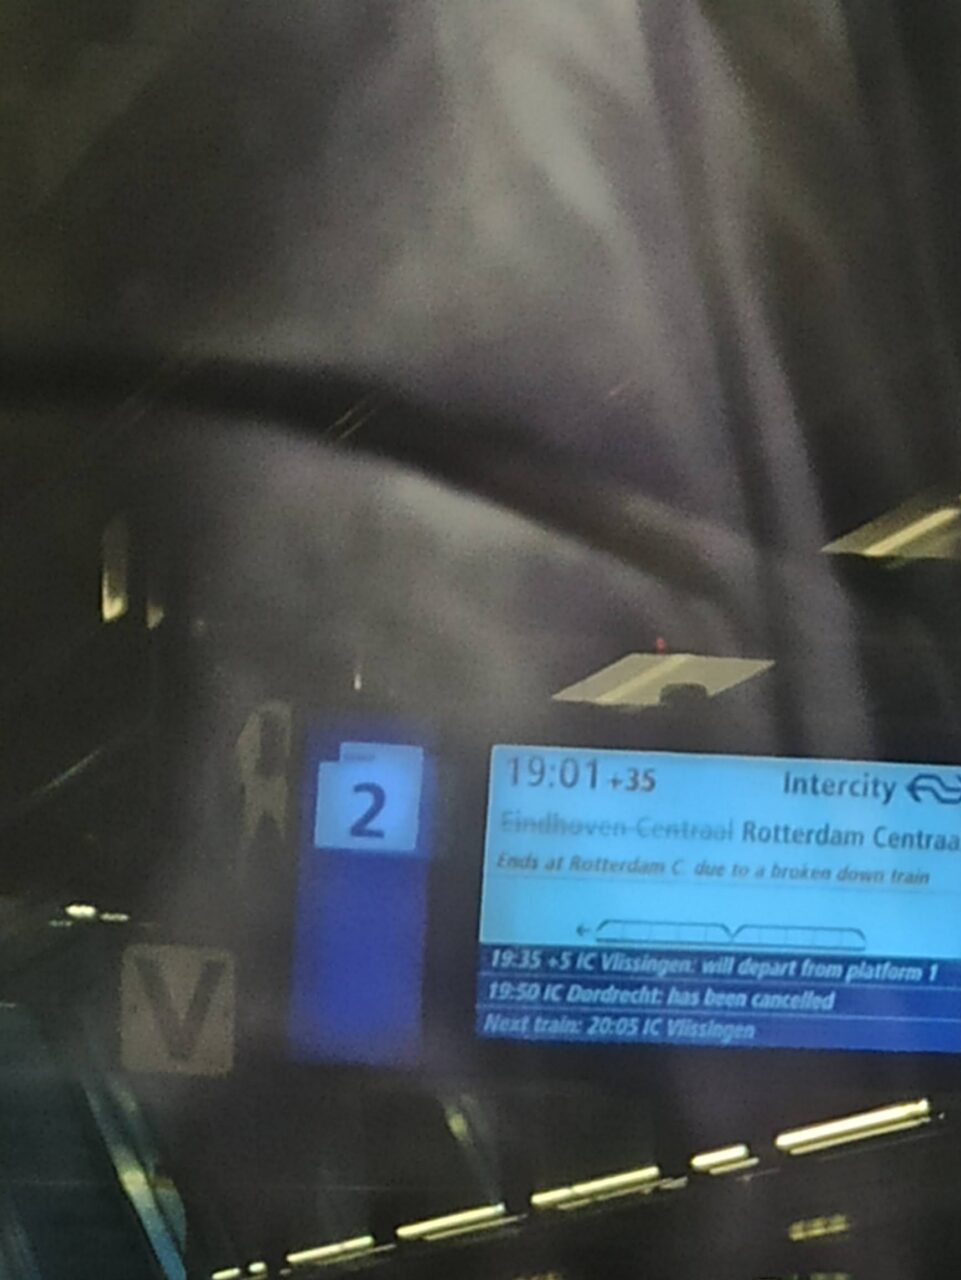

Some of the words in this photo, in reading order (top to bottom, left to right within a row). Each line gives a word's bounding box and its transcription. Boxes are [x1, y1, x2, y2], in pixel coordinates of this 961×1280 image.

[507, 755, 598, 790] 19:01
[608, 766, 657, 792] +35
[783, 771, 897, 805] Intercity
[350, 782, 386, 839] 2
[500, 810, 627, 838] Eindhoven
[636, 817, 734, 842] Centraal
[742, 820, 865, 847] Rotterdam
[496, 853, 538, 871] Ends
[544, 856, 564, 872] at
[569, 855, 665, 874] Rotterdam
[694, 859, 725, 877] due
[731, 863, 749, 877] to
[754, 865, 765, 878] a
[770, 861, 832, 881] broken
[836, 865, 884, 883] down
[891, 867, 930, 885] train
[492, 949, 541, 969] 19:35
[576, 952, 596, 970] IC
[702, 956, 735, 975] will
[737, 957, 798, 981] depart
[801, 958, 843, 979] from
[845, 961, 923, 984] platform
[489, 981, 540, 1001] 19:50
[543, 982, 564, 1000] IC
[667, 986, 699, 1006] has
[704, 987, 747, 1007] been
[751, 989, 836, 1011] cancelled
[483, 1013, 530, 1033] Next
[586, 1015, 639, 1036] 20:05
[643, 1017, 662, 1035] IC
[667, 1018, 755, 1044] Vlissingen
